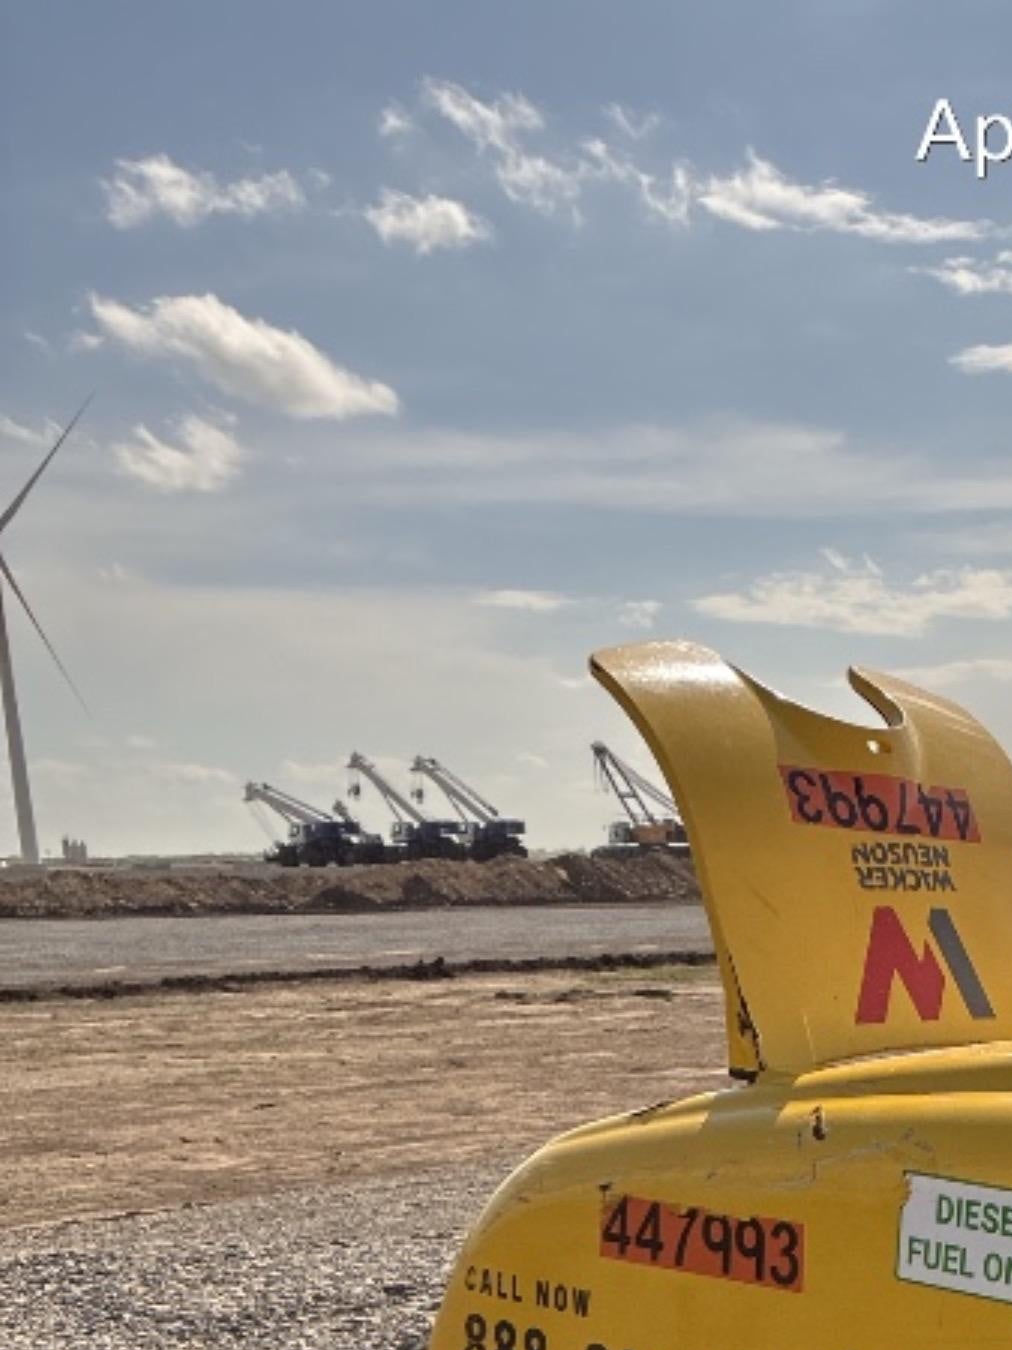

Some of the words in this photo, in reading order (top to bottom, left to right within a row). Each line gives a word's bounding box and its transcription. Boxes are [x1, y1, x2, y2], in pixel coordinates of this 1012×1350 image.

[787, 768, 972, 840] 447993
[851, 842, 951, 868] NEUSON
[856, 867, 957, 891] WACKER
[602, 1194, 800, 1286] 447993
[907, 1235, 975, 1279] FUEL
[464, 1265, 523, 1303] CALL
[535, 1280, 592, 1319] NOW
